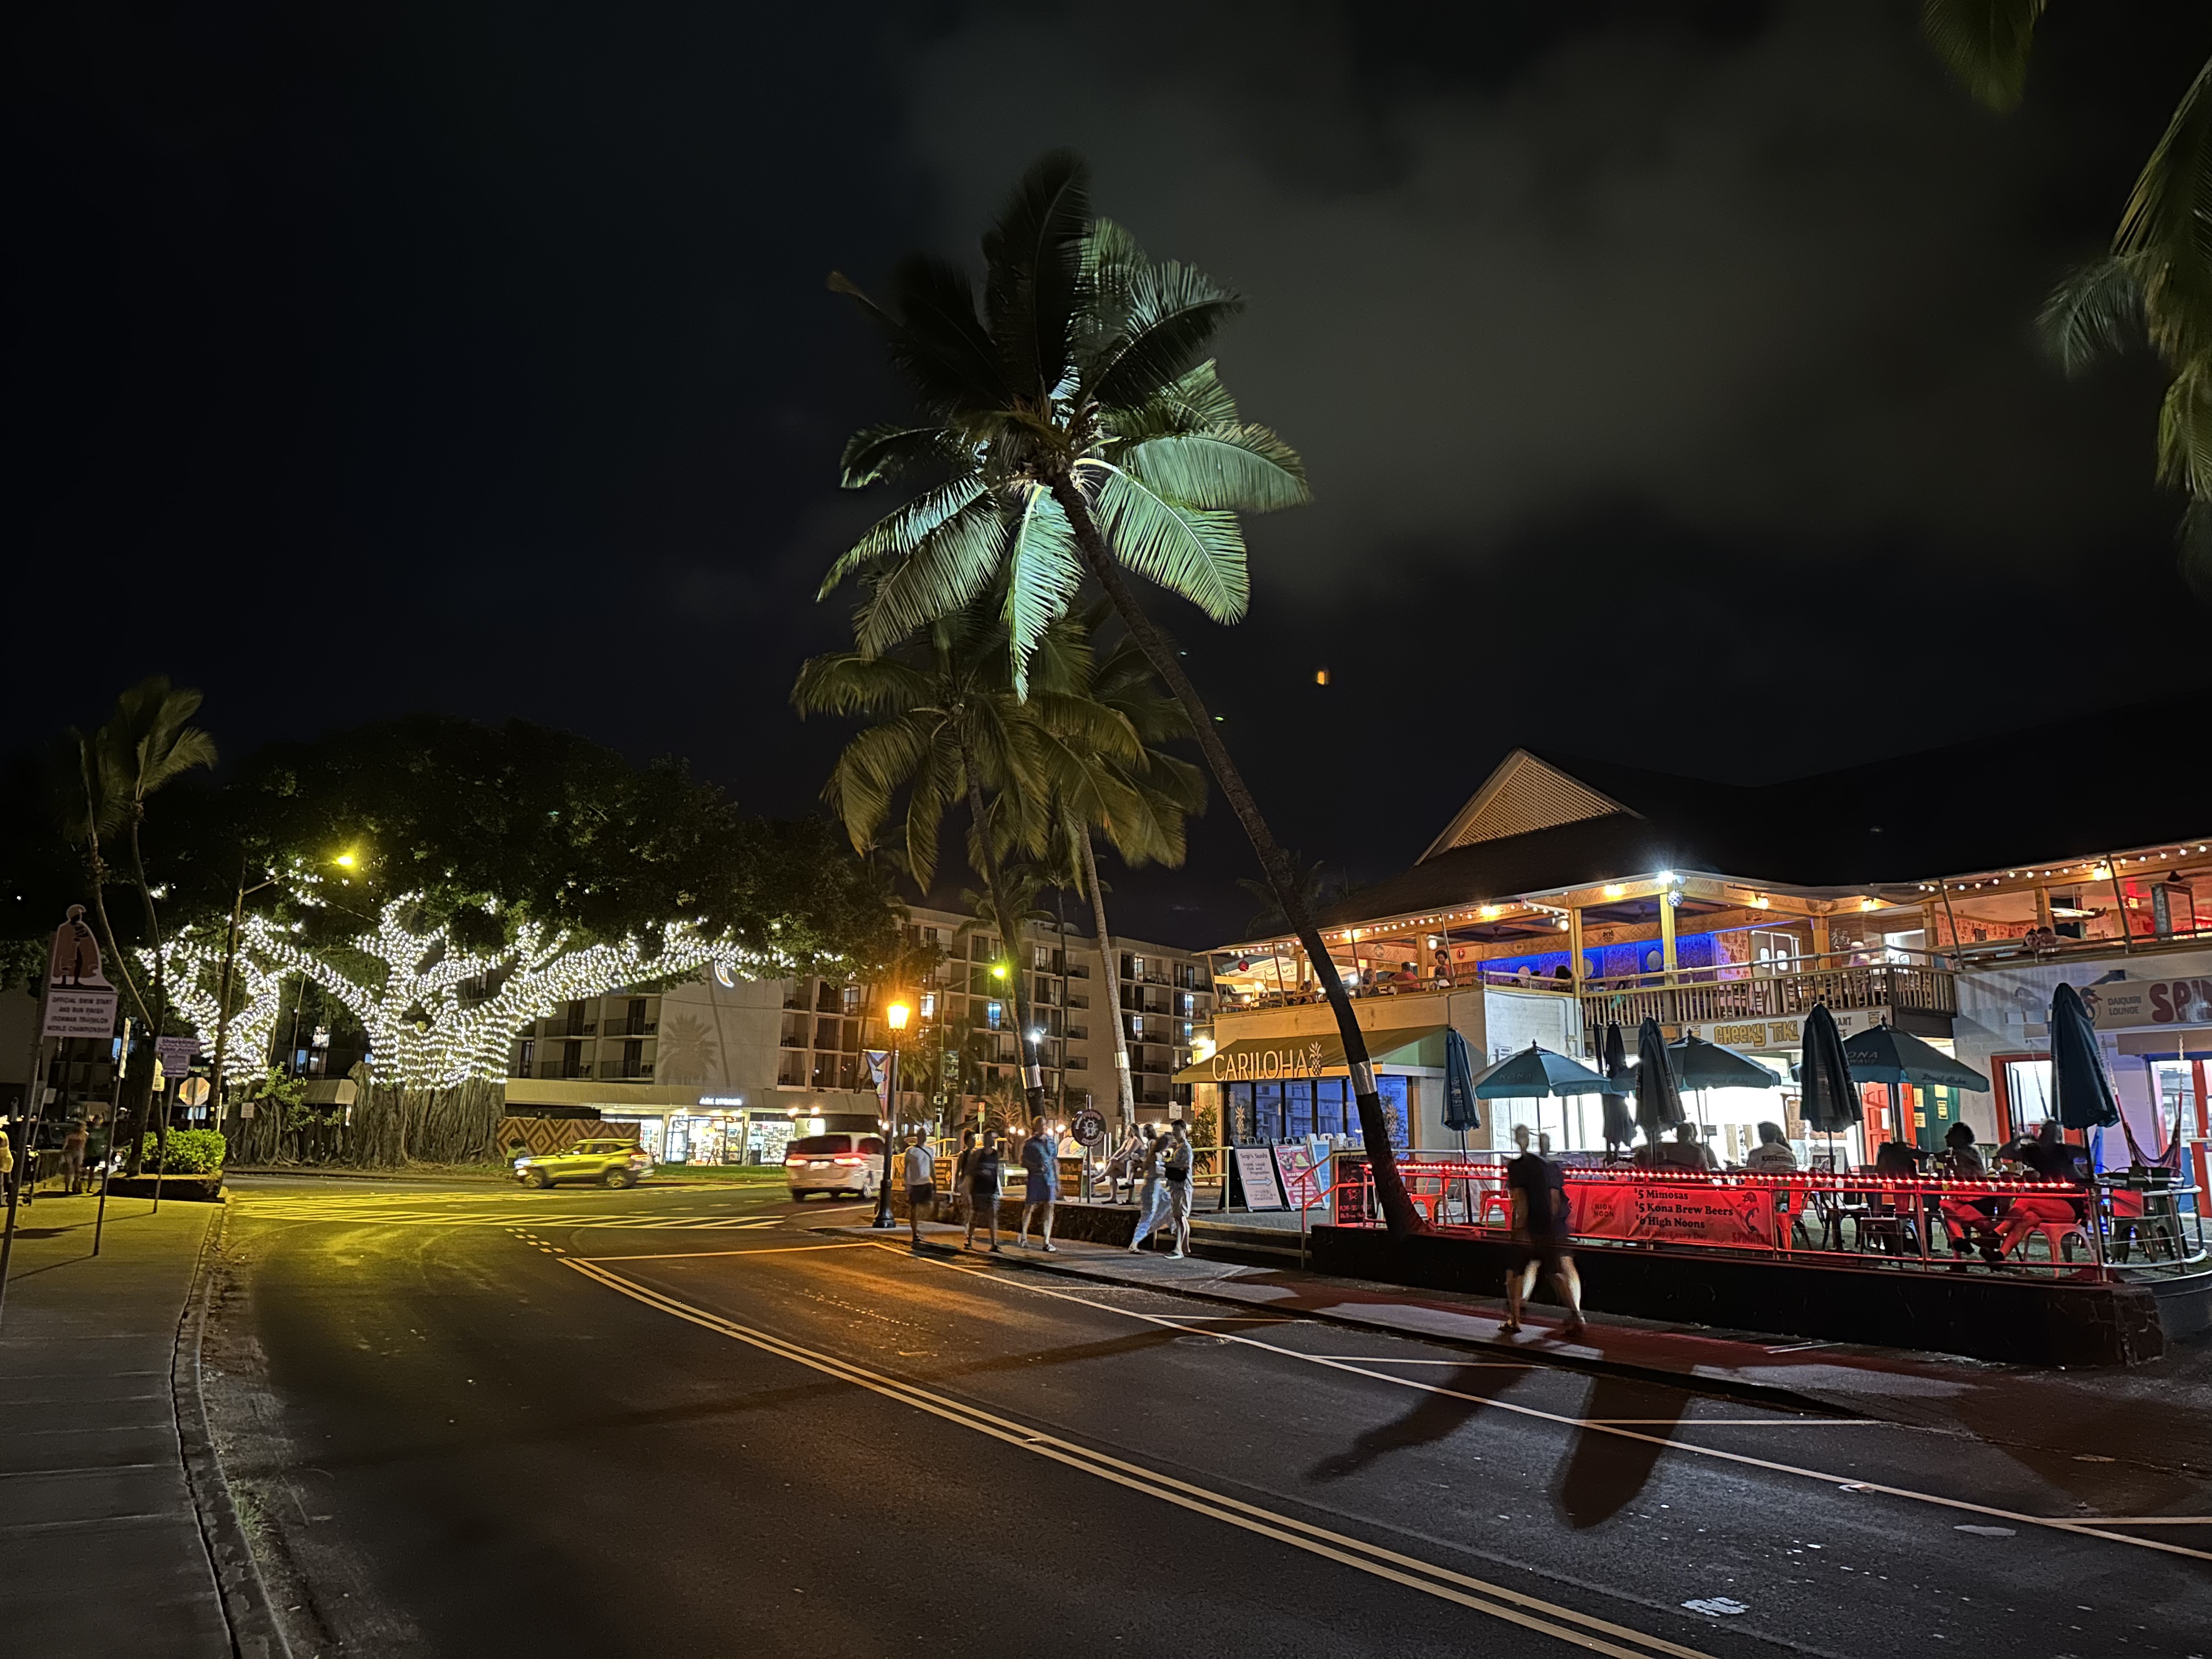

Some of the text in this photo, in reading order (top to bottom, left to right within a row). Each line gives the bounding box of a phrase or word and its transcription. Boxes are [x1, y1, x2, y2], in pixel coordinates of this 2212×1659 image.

[2107, 996, 2142, 1006] DAIQUIRI
[2109, 1006, 2140, 1015] LOUNGE
[1212, 1048, 1311, 1082] CARILOHA
[1634, 1187, 1689, 1200] $5 Mimosas
[1635, 1200, 1734, 1216] $5 Kona Brew Beers
[1635, 1214, 1706, 1229] $6 High Noons
